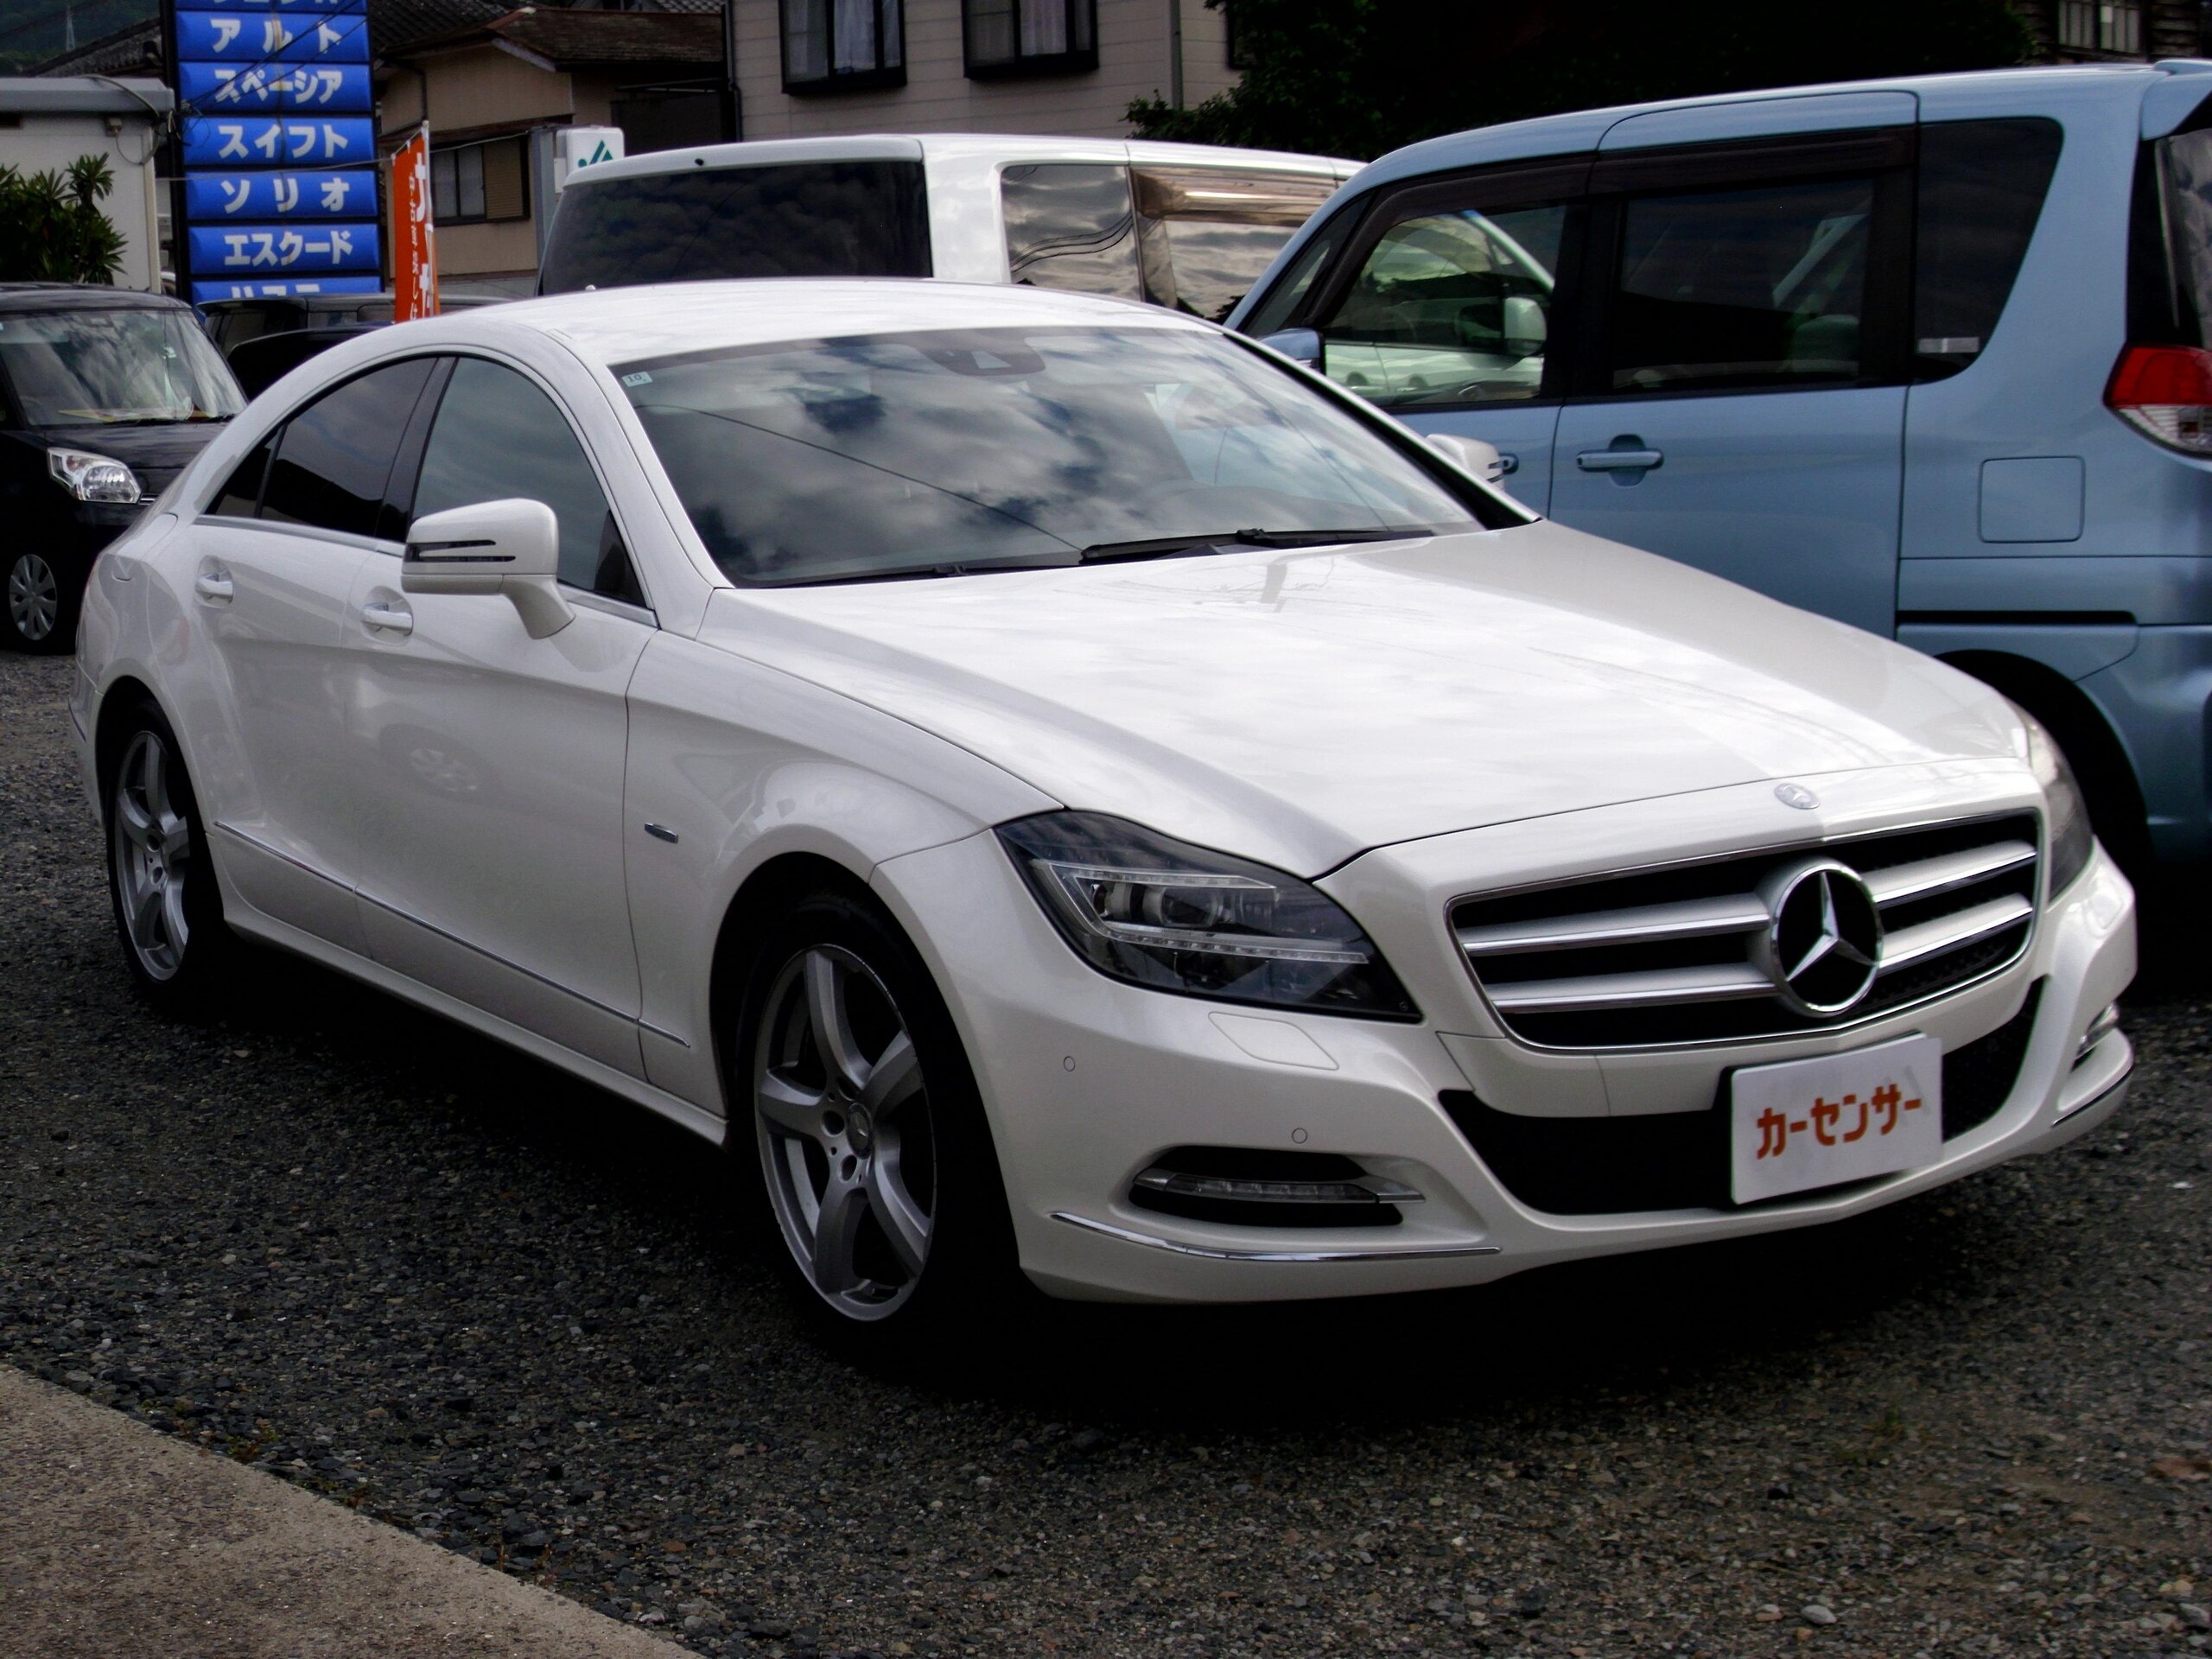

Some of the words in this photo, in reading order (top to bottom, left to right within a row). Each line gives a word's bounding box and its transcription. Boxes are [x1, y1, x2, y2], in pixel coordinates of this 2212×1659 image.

[211, 19, 342, 54] アルト
[214, 69, 343, 104] スペーシア
[219, 124, 348, 159] スイフト
[220, 177, 350, 214] ソリオ
[224, 230, 353, 267] エスクード
[1757, 1084, 1922, 1160] カーセンサー
